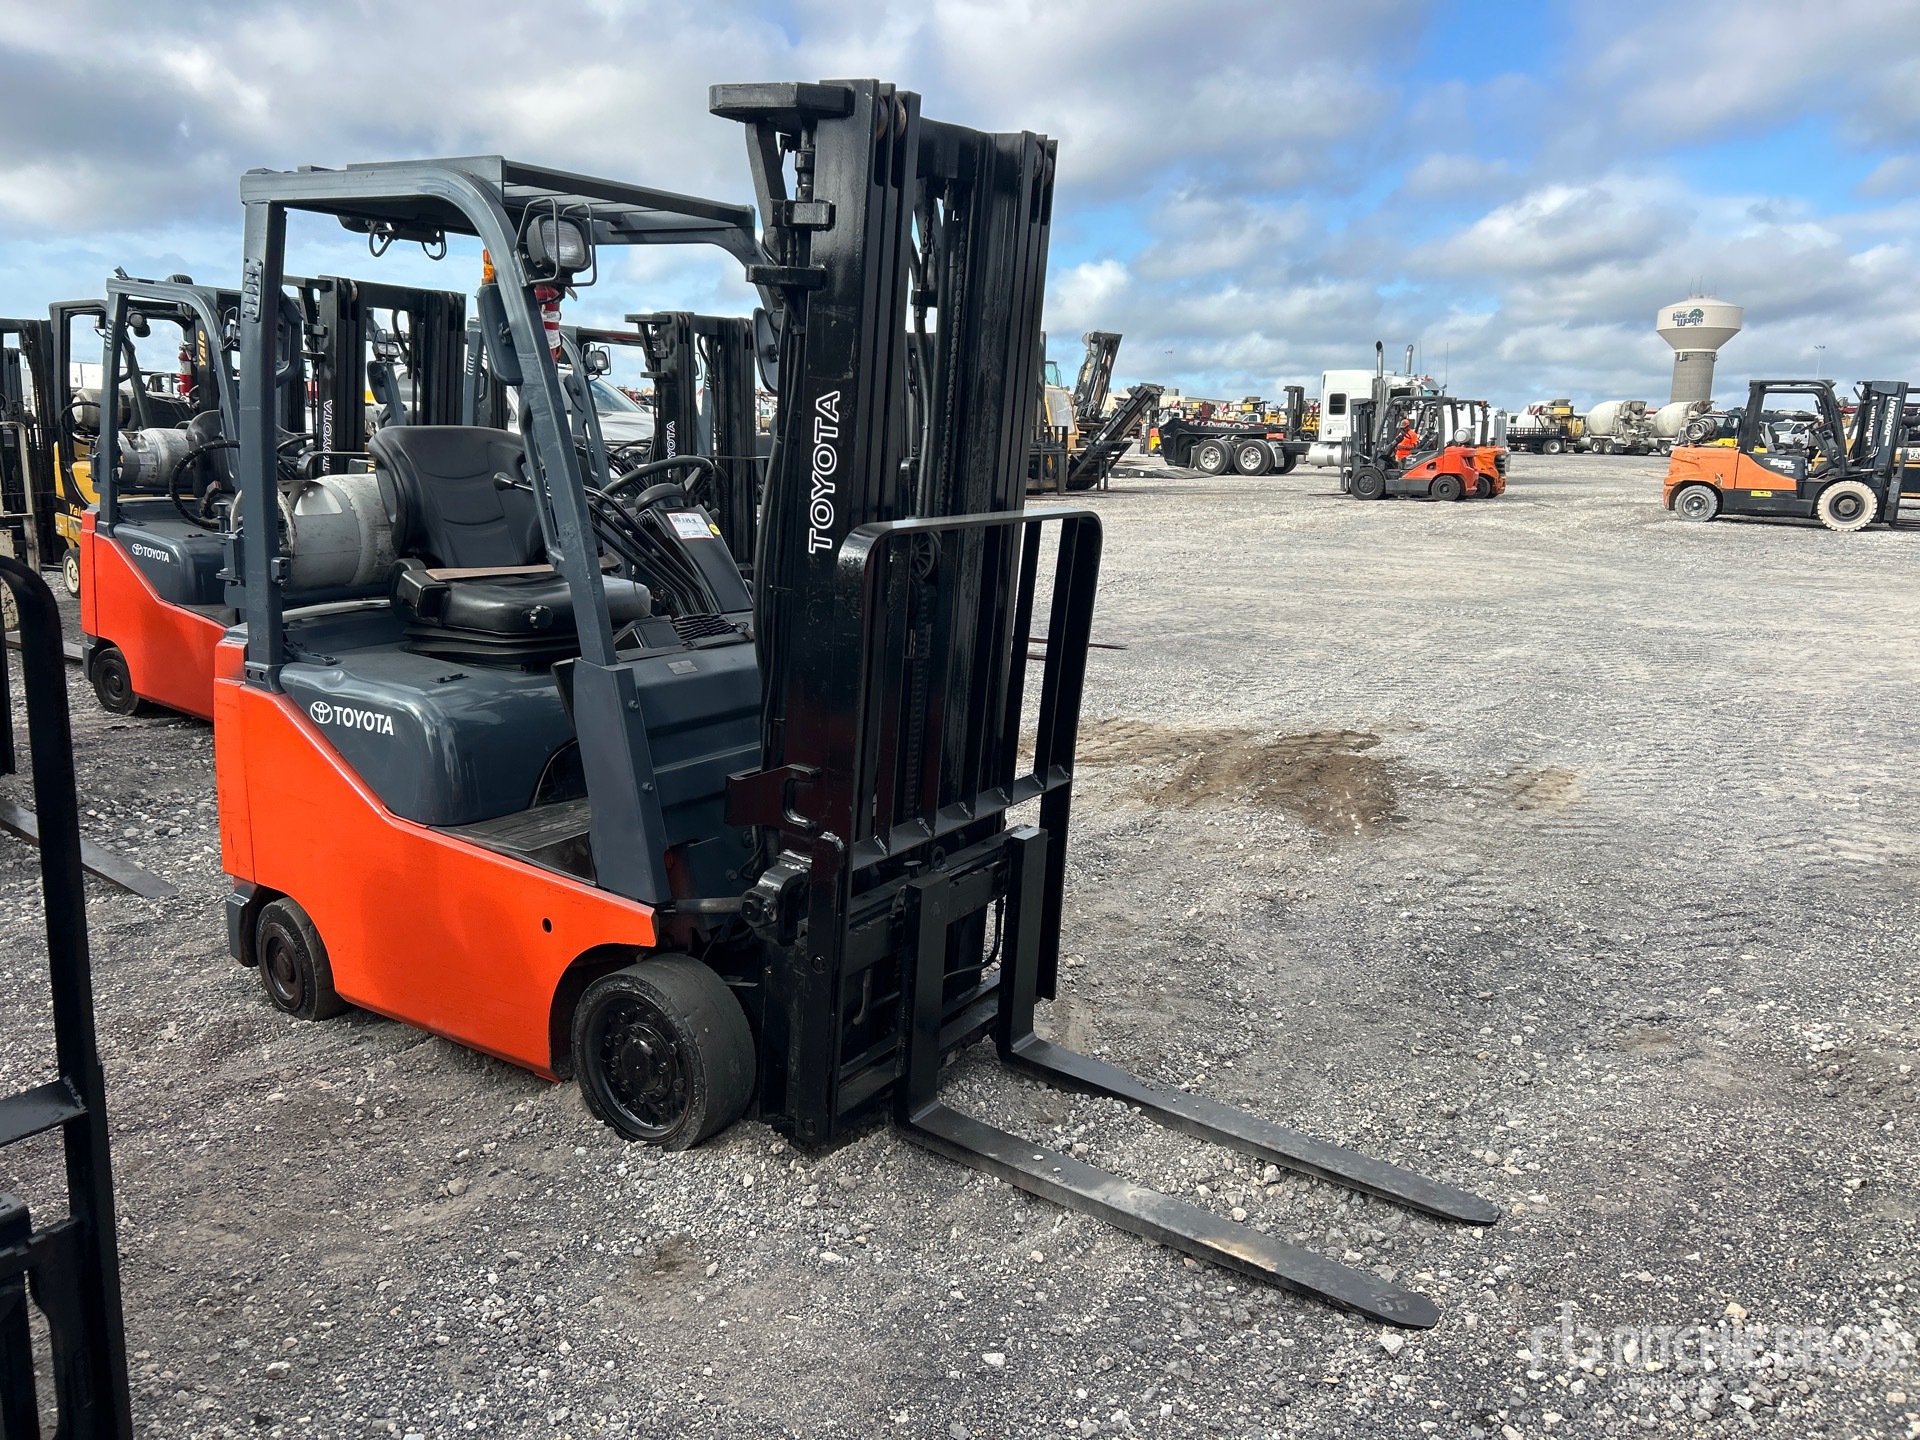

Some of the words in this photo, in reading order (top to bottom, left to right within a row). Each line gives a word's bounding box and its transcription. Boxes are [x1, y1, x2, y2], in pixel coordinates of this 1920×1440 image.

[1884, 400, 1897, 436] DOOSAN
[793, 390, 840, 554] TOYOTA
[143, 546, 170, 563] TOYOTA
[333, 705, 394, 736] TOYOTA
